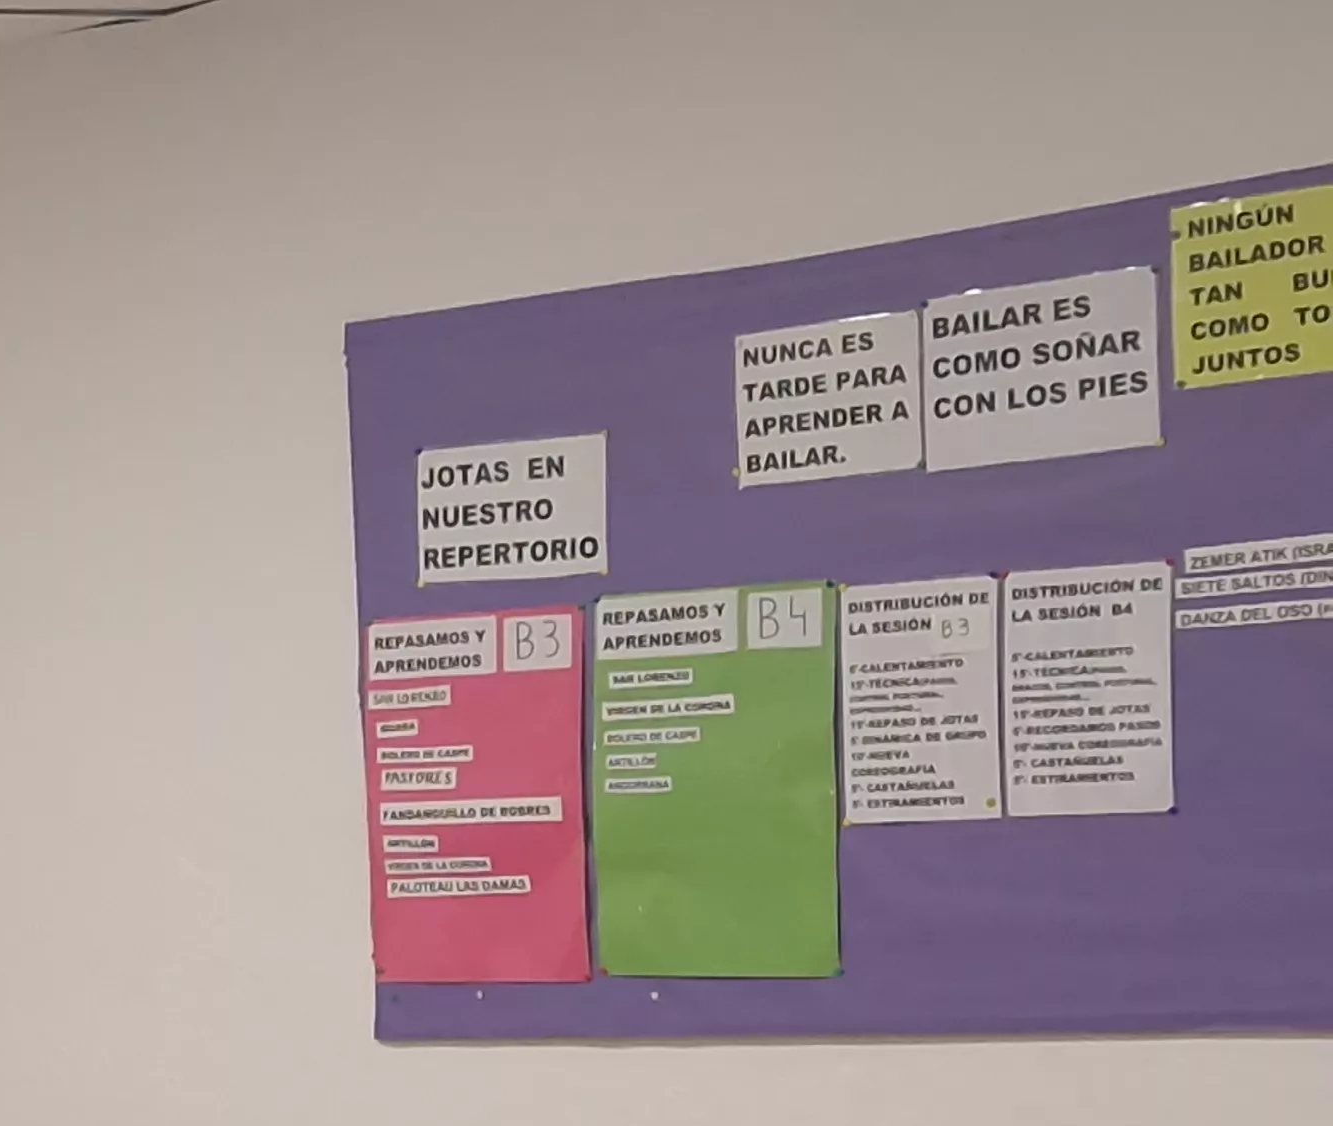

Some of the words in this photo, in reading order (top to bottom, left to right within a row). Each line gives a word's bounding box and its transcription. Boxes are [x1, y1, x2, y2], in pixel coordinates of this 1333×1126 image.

[1188, 203, 1294, 239] NINGÚN
[1189, 235, 1325, 272] BAILADOR
[1189, 282, 1243, 306] TAN
[1293, 268, 1333, 292] BU
[933, 303, 1042, 339] BAILAR
[1054, 295, 1091, 321] ES
[1191, 313, 1269, 340] COMO
[743, 338, 833, 367] NUNCA
[842, 332, 874, 354] ES
[933, 348, 1020, 378] COMO
[1033, 330, 1141, 365] SOÑAR
[1192, 343, 1301, 374] JUNTOS
[743, 374, 828, 402] TARDE
[837, 364, 906, 391] PARA
[934, 391, 996, 419] CON
[1008, 382, 1067, 410] LOS
[1079, 371, 1148, 400] PIES
[745, 404, 882, 438] APRENDER
[891, 401, 909, 420] A
[421, 461, 509, 489] JOTAS
[528, 456, 564, 480] EN
[746, 445, 846, 473] BAILAR.
[422, 499, 553, 530] NUESTRO
[424, 536, 599, 570] REPERTORIO
[1012, 579, 1134, 600] DISTRIBUCIÓN
[1140, 578, 1162, 591] DE
[1181, 581, 1226, 594] SIETE
[1231, 573, 1295, 590] SALTOS
[602, 605, 708, 625] REPASAMOS
[714, 603, 725, 617] Y
[848, 592, 963, 614] DISTRIBUCIÓN
[969, 592, 989, 604] DE
[1012, 609, 1032, 622] LA
[1038, 602, 1101, 621] SESIÓN
[1181, 610, 1235, 626] DANZA
[1241, 608, 1271, 622] DEL
[1277, 604, 1312, 618] OSO
[374, 631, 470, 649] REPASAMOS
[475, 630, 486, 642] Y
[603, 629, 722, 650] APRENDEMOS
[849, 623, 867, 635] LA
[873, 617, 931, 634] SESIÓN
[375, 654, 481, 673] APRENDEMOS
